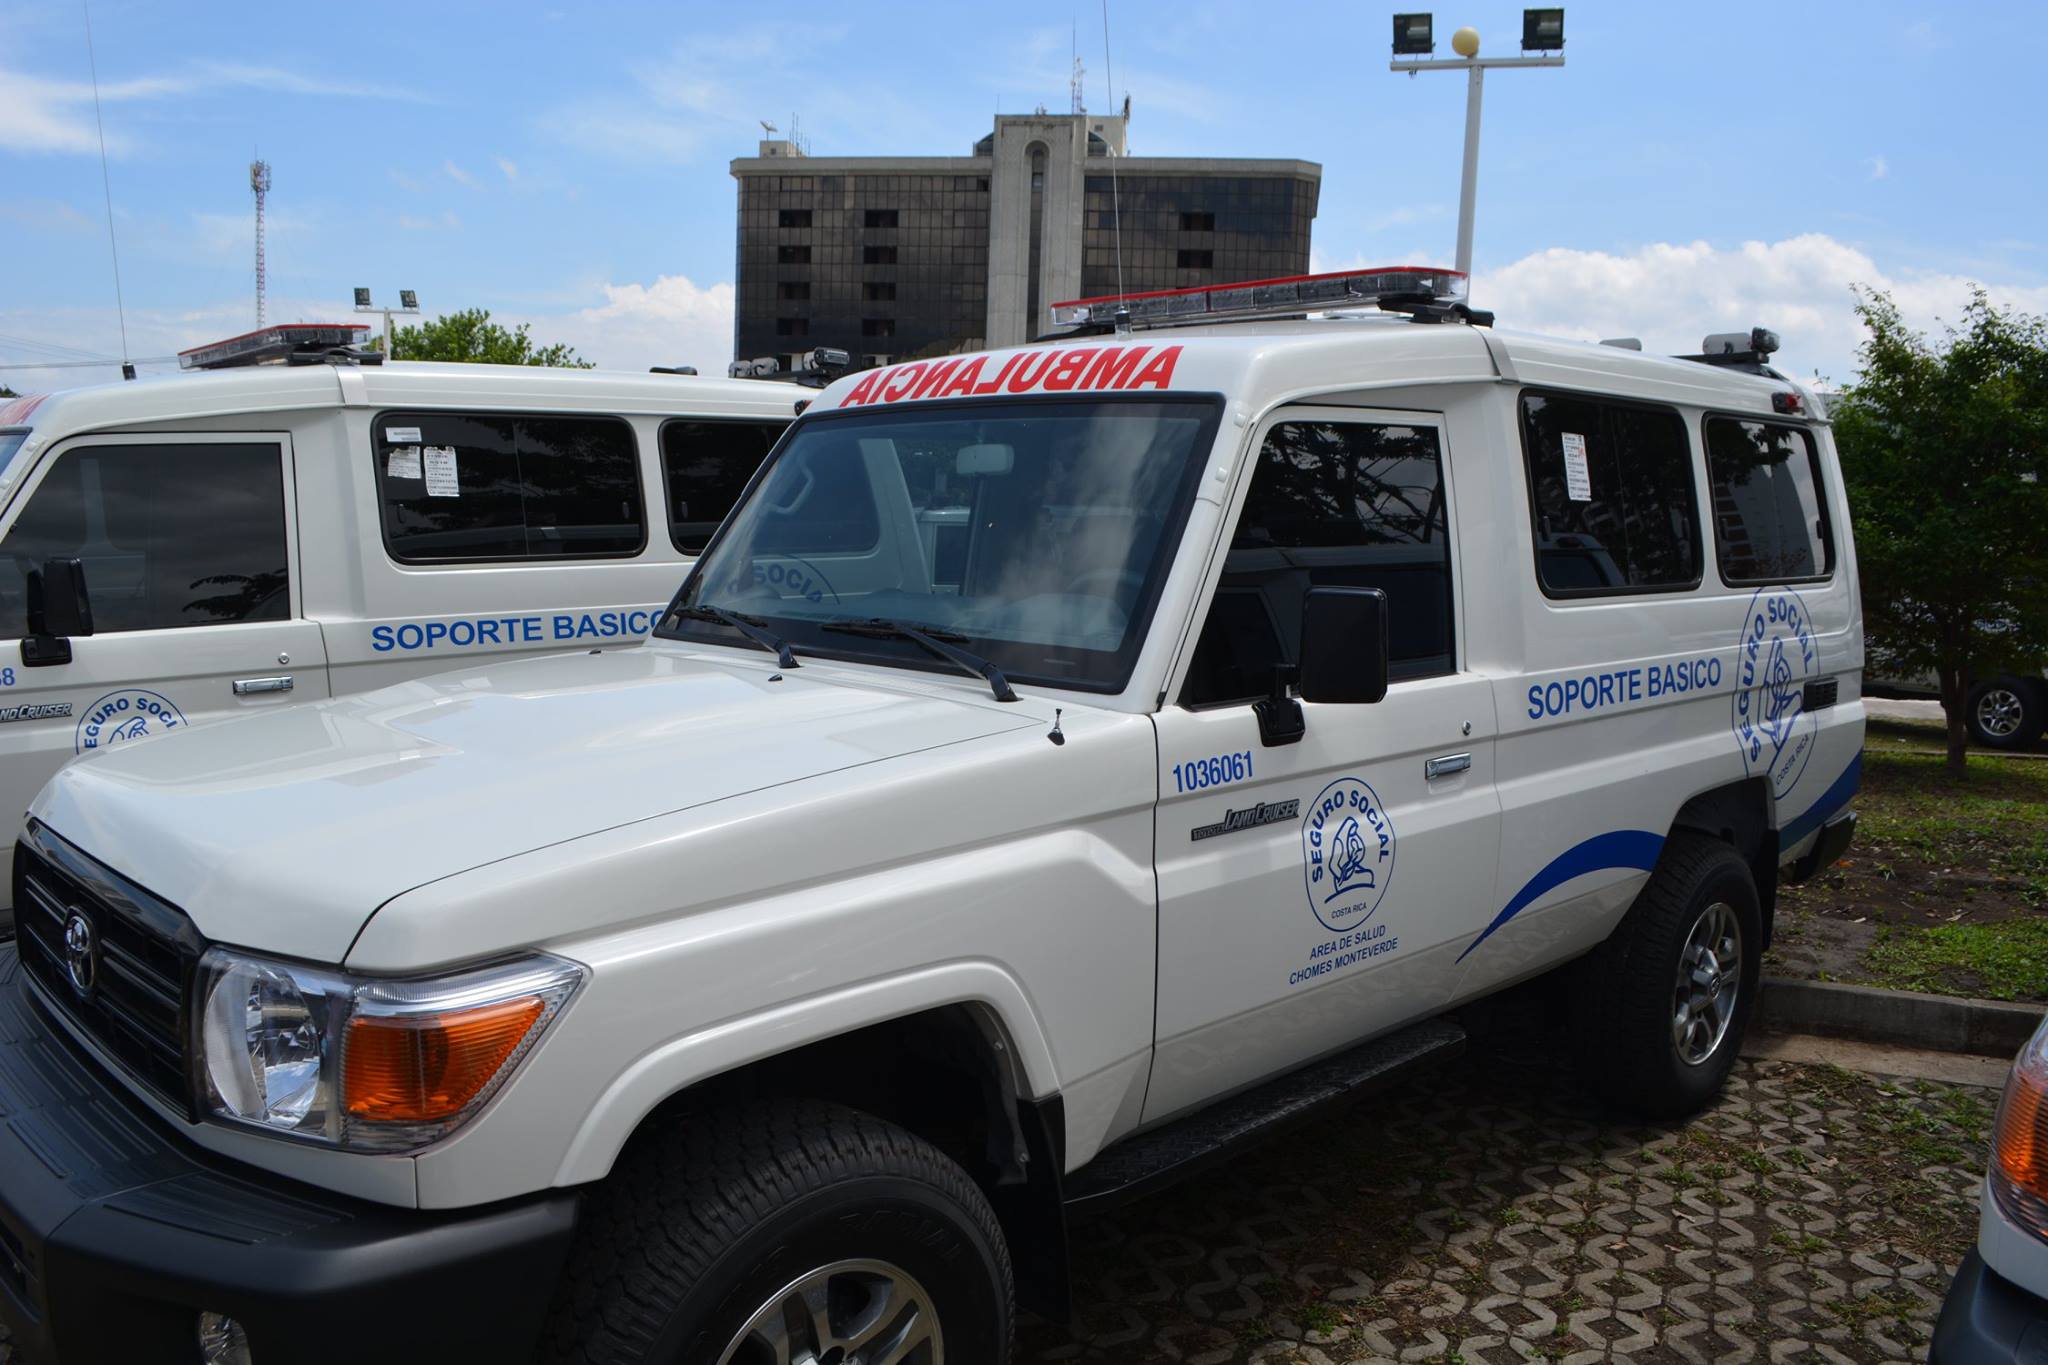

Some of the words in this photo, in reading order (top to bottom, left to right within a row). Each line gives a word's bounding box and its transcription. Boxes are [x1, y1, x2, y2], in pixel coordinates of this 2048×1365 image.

[751, 564, 823, 603] SOCIA
[371, 617, 544, 652] SOPORTE
[1528, 669, 1641, 720] SOPORTE
[1648, 657, 1722, 698] BASICO
[1739, 613, 1765, 762] SEGURO
[1768, 597, 1813, 674] SOCIAL
[84, 698, 130, 749] EGURO
[136, 697, 177, 729] SOCI
[1173, 751, 1254, 792] 1036061
[1309, 790, 1345, 883] SEGURO
[1349, 790, 1390, 864] SOCIAL
[1331, 907, 1352, 919] COSTA
[1353, 902, 1367, 913] RICA
[1289, 960, 1332, 985] CHOMES
[1334, 938, 1398, 969] MONTEVERDE
[1310, 941, 1337, 960] AREA
[1339, 935, 1353, 950] DE
[1355, 924, 1386, 945] SALUD
